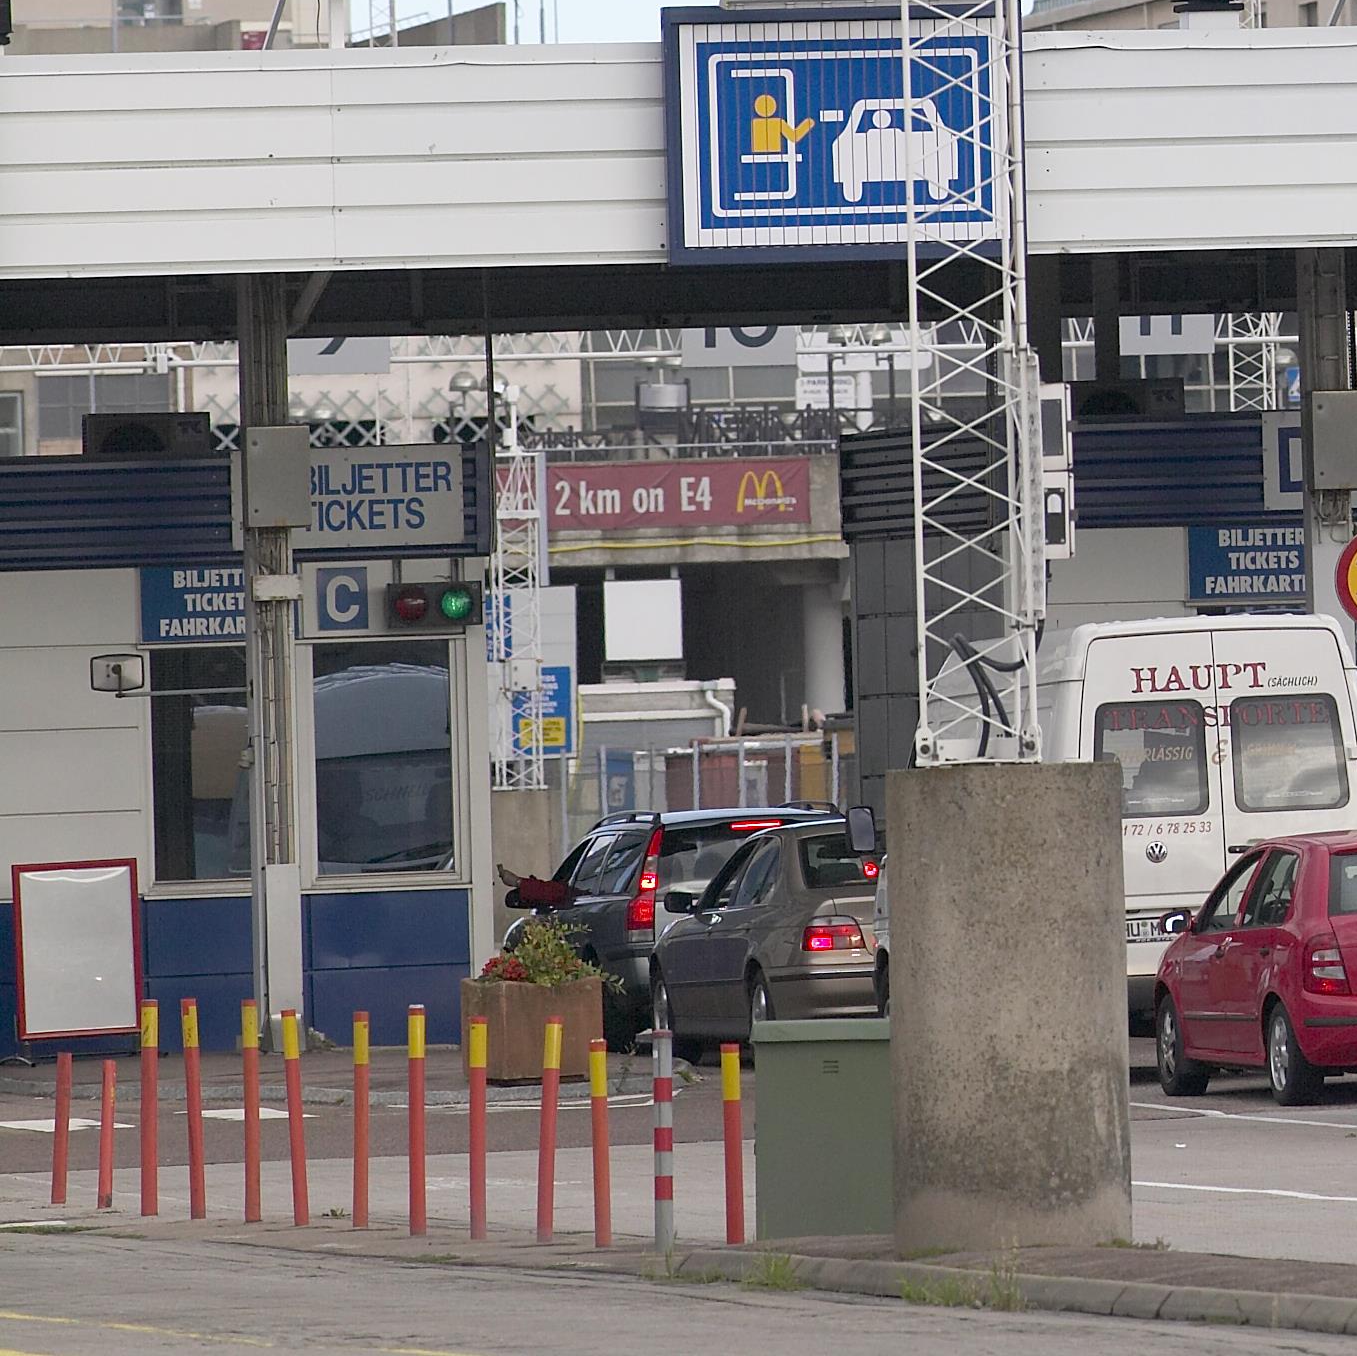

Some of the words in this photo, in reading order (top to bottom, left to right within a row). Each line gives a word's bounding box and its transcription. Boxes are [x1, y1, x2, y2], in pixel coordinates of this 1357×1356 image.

[555, 480, 571, 516] 2
[579, 480, 621, 515] km
[632, 485, 665, 513] on
[680, 476, 713, 511] E4
[1228, 551, 1300, 570] TICKETS
[173, 568, 246, 589] BILJETT
[184, 592, 246, 612] TICKET
[326, 575, 360, 623] C
[159, 616, 246, 637] FAHRKAR
[1130, 662, 1266, 693] HAUPT
[1103, 701, 1330, 731] TRANSPORTE
[1156, 824, 1163, 835] 6
[1167, 822, 1179, 834] 78
[1183, 822, 1196, 834] 25
[1199, 821, 1212, 833] 33
